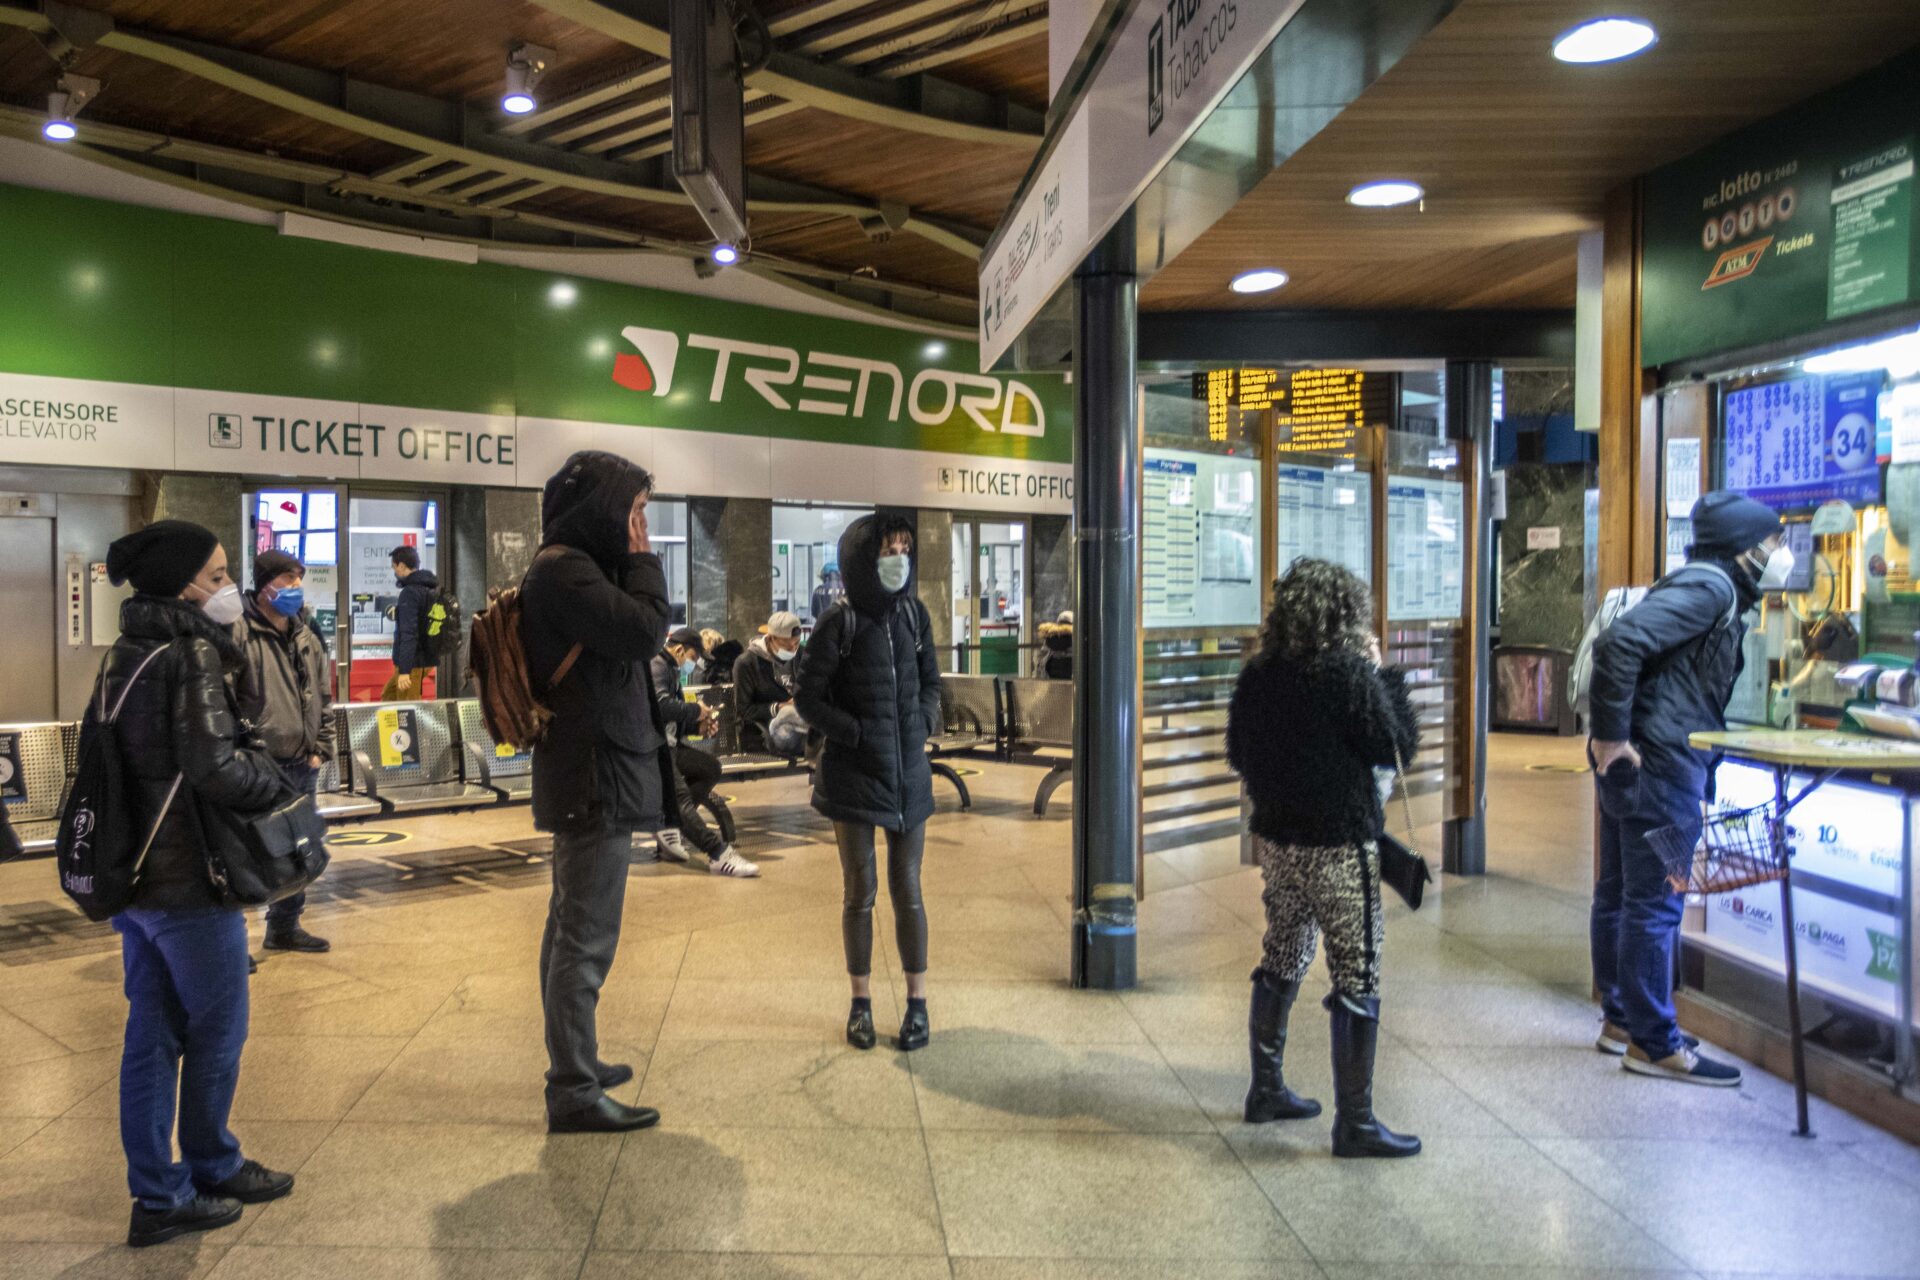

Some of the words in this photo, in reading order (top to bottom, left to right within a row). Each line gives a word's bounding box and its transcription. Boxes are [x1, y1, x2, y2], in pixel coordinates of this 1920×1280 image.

[1167, 0, 1237, 107] Tobaccos
[1043, 171, 1061, 225] Treni
[1720, 170, 1761, 204] lotto
[1703, 190, 1795, 247] LOTTO
[1775, 232, 1814, 257] Tickets
[1725, 255, 1747, 272] ATM
[687, 333, 1045, 438] TRENORD
[0, 419, 97, 442] LEVATOR
[252, 415, 386, 457] TICKET
[398, 426, 515, 465] OFFICE
[1837, 426, 1867, 458] 34
[958, 468, 1021, 496] TICKET
[1026, 474, 1073, 500] OFFIC
[363, 547, 393, 558] ENTR
[1818, 824, 1838, 844] 10
[1821, 929, 1846, 947] PAGA
